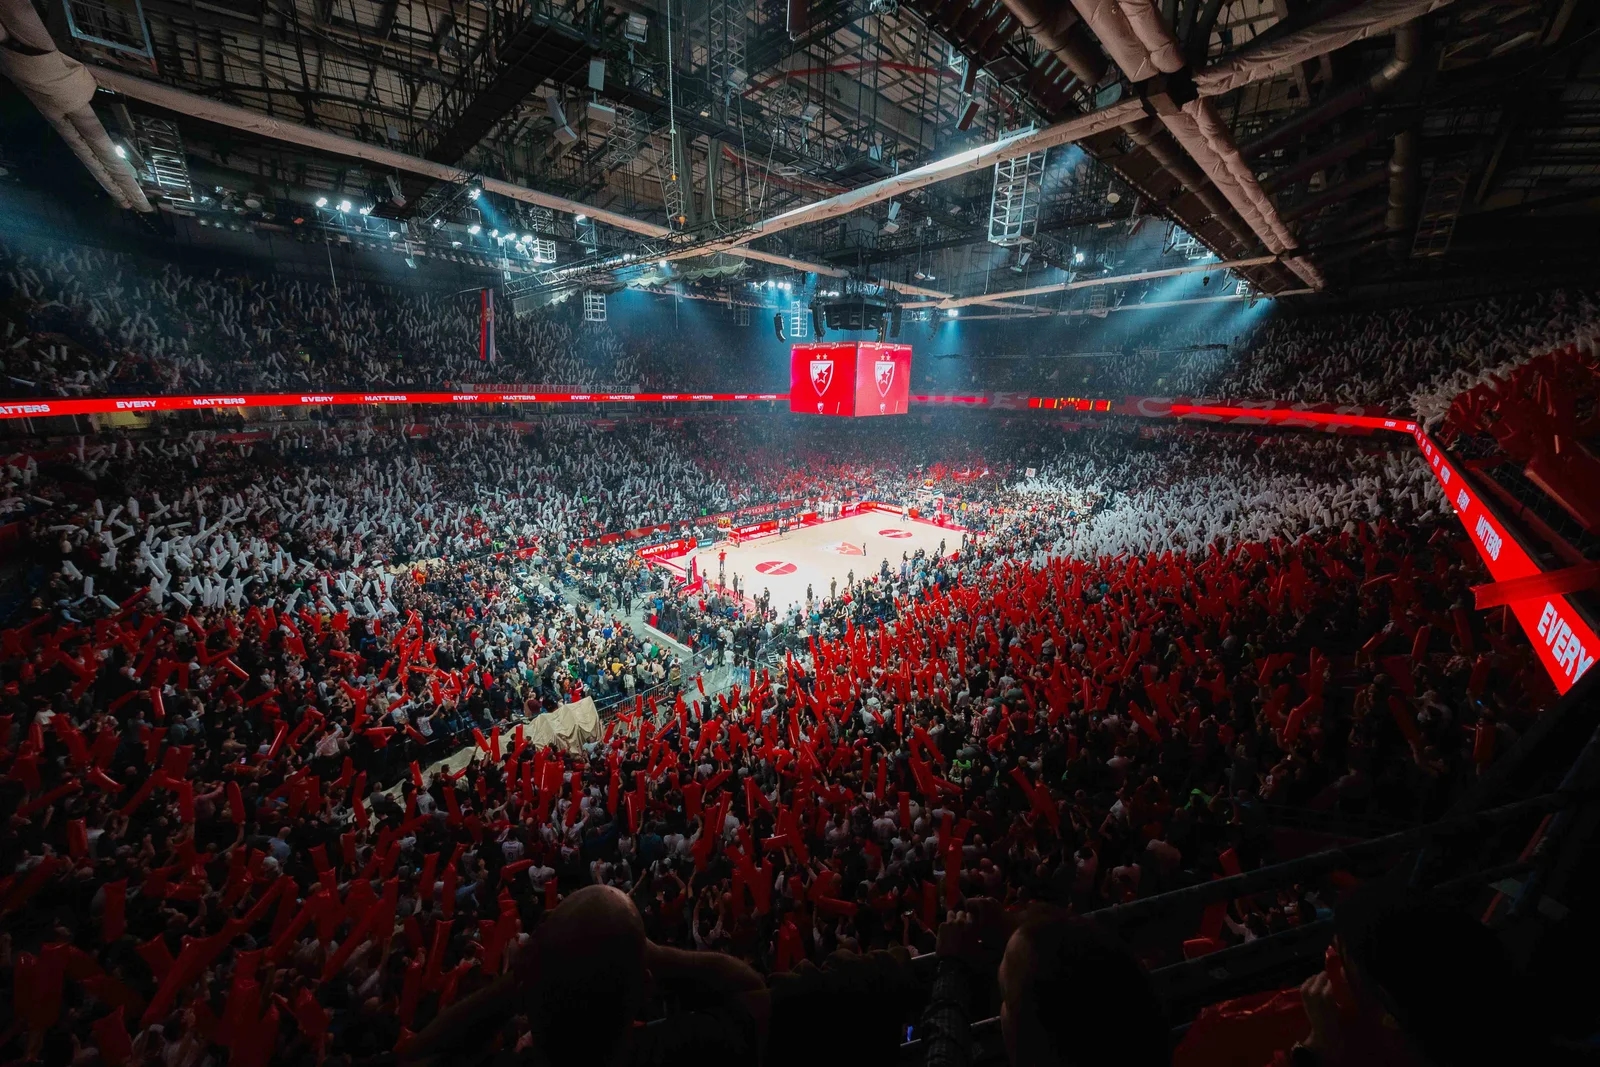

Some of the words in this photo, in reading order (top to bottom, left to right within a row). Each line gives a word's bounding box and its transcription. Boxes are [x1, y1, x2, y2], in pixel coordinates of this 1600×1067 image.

[193, 397, 246, 405] MATTERS
[741, 525, 760, 534] EVERY
[1475, 515, 1502, 561] MATTERS
[1537, 601, 1594, 684] EVERY
